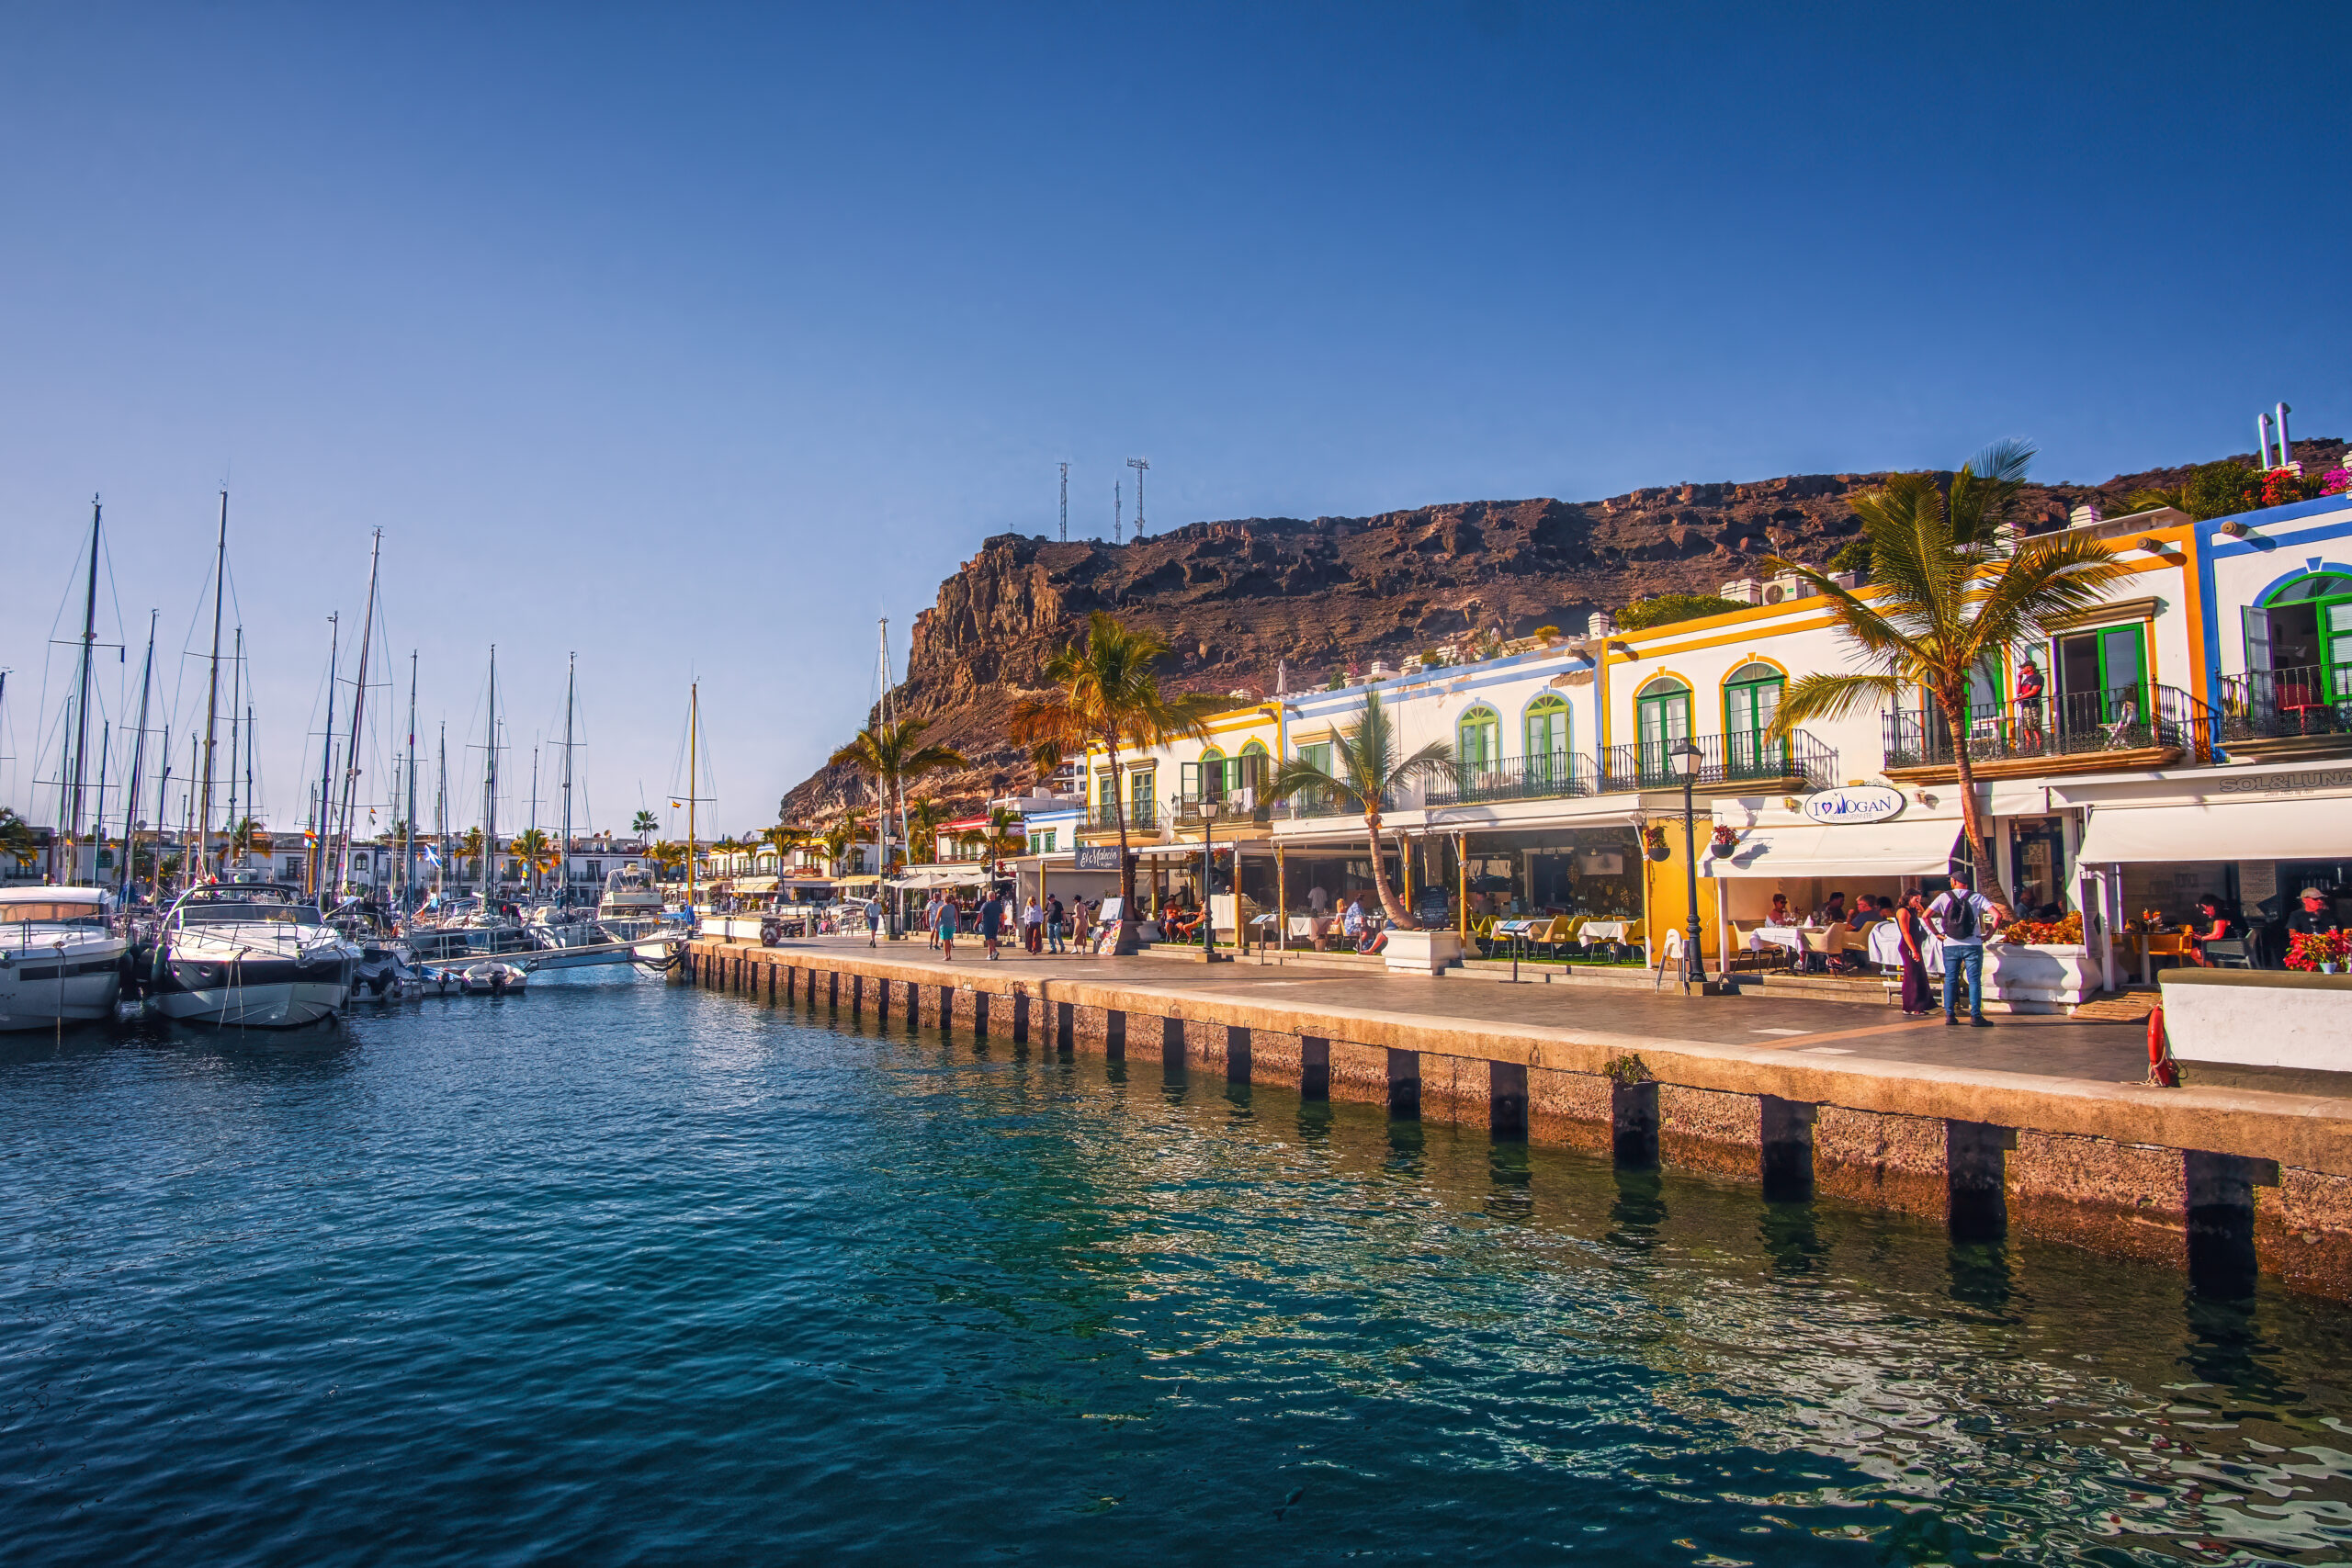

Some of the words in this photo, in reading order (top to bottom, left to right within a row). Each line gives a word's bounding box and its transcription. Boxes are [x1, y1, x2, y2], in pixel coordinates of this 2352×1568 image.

[2220, 771, 2352, 792] SOL&LUNA
[1813, 802, 1819, 816] I
[1828, 812, 1873, 821] RESTAURANTE
[1080, 851, 1090, 868] El
